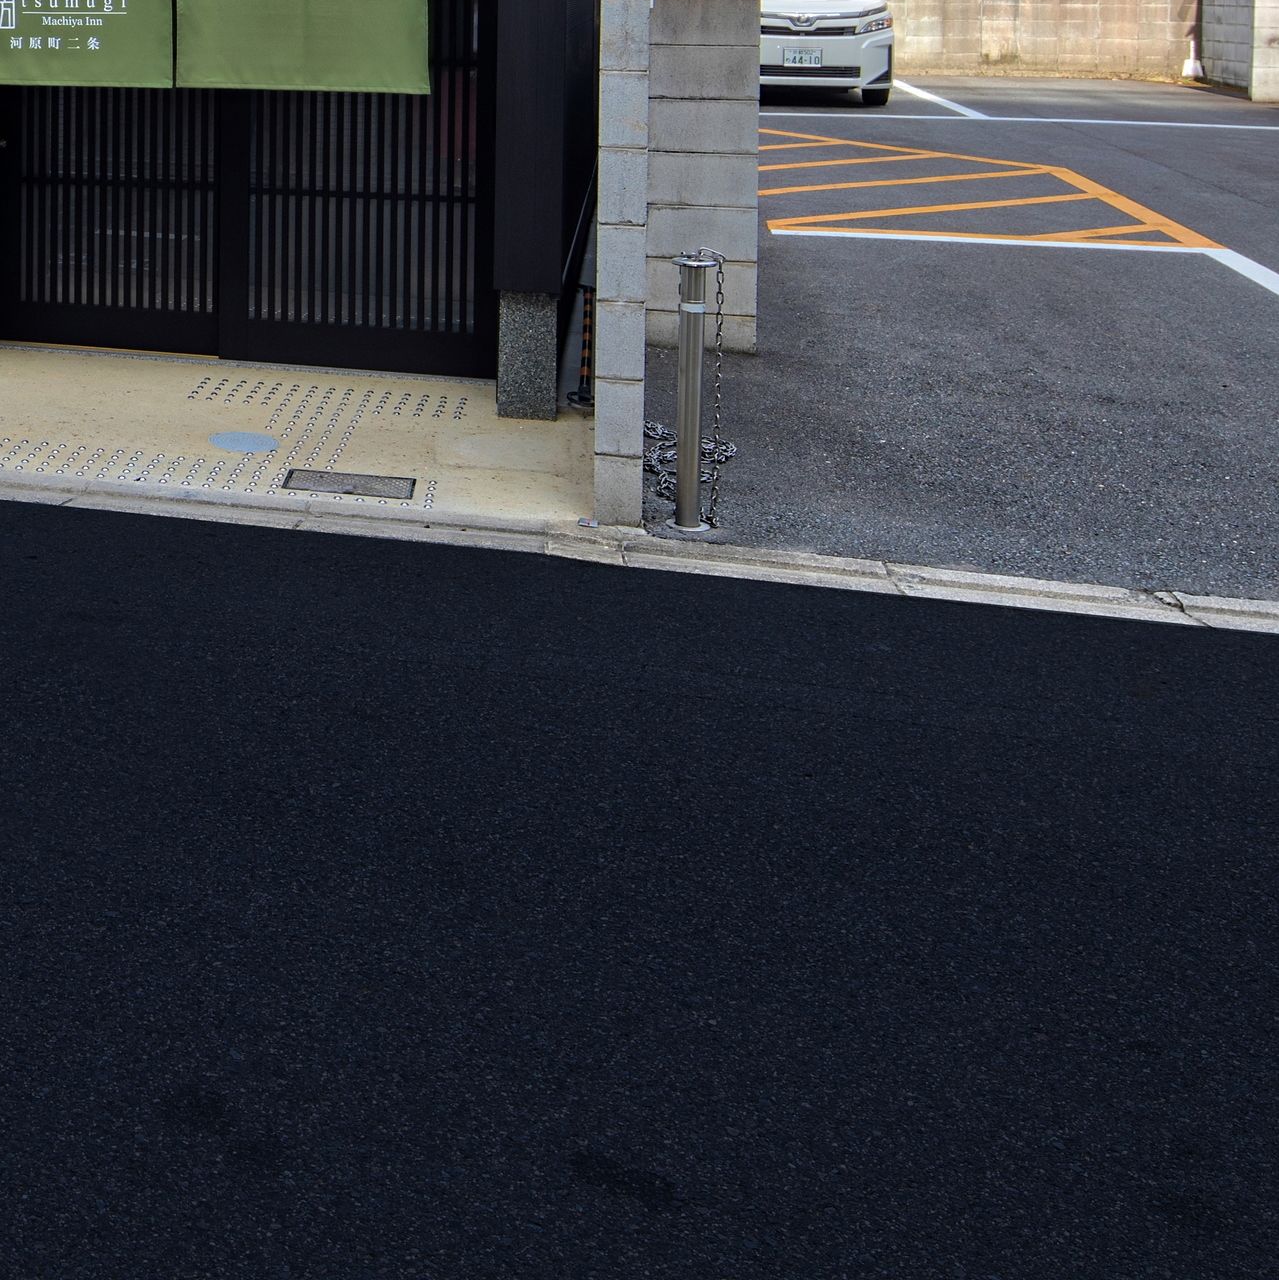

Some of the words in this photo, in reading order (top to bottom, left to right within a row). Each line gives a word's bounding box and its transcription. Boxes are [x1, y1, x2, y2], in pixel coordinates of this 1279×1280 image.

[42, 16, 83, 27] Machiya
[85, 16, 103, 26] Inn
[10, 37, 100, 50] 河原町二条
